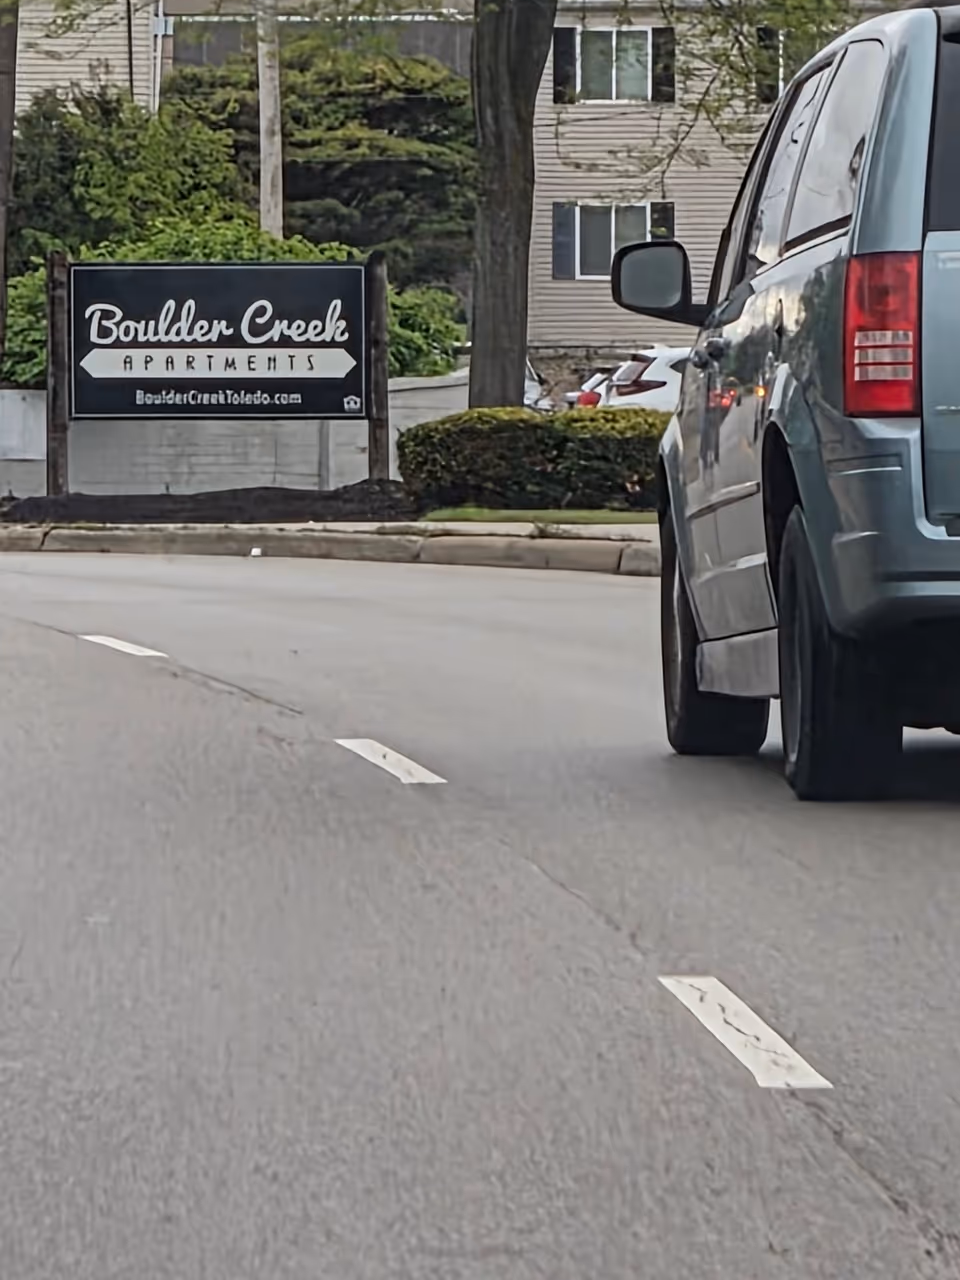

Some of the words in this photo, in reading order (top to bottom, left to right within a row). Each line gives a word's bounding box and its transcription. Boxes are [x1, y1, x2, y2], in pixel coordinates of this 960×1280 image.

[85, 299, 234, 345] Boulder
[240, 299, 350, 344] Creek
[123, 354, 316, 372] APARTMENTS
[135, 389, 302, 406] BoulderCreekToledo.com
